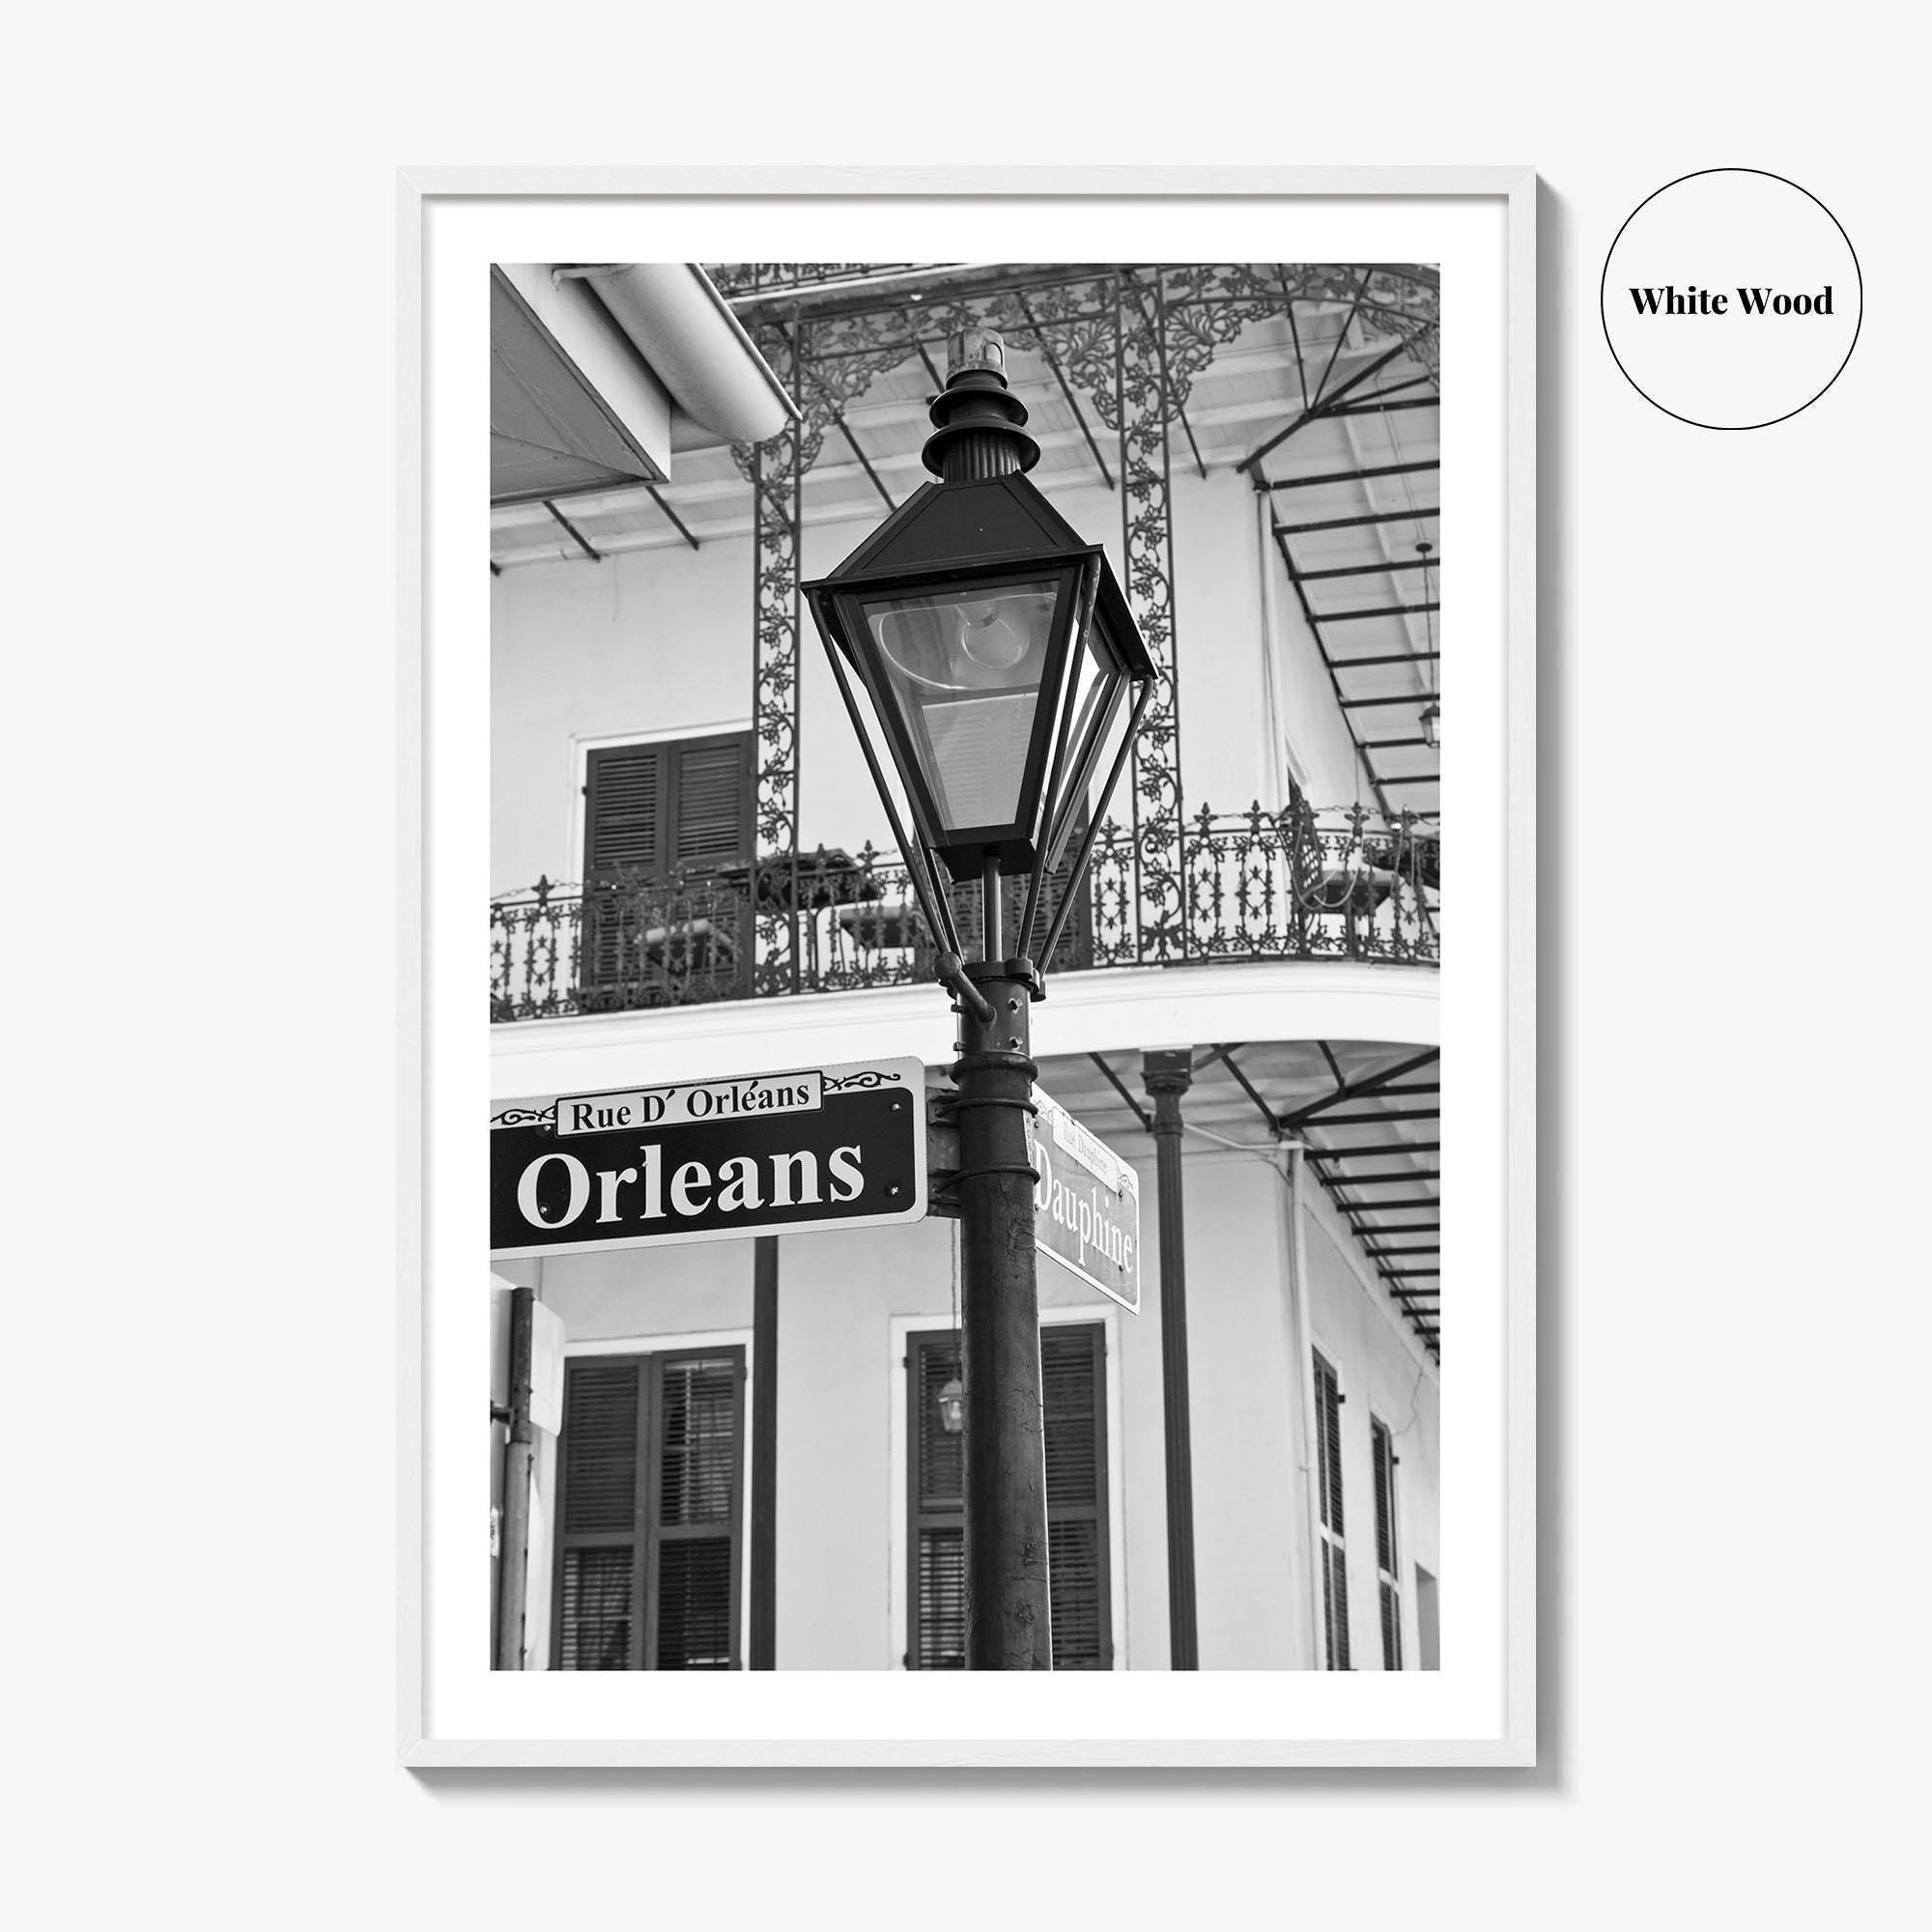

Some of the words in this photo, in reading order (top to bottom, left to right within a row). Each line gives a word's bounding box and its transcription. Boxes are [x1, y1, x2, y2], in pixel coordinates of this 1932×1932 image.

[571, 1103, 631, 1131] Rue
[687, 1080, 810, 1118] Orléans
[517, 1144, 866, 1230] Orleans
[1034, 1139, 1134, 1274] Dauphine
